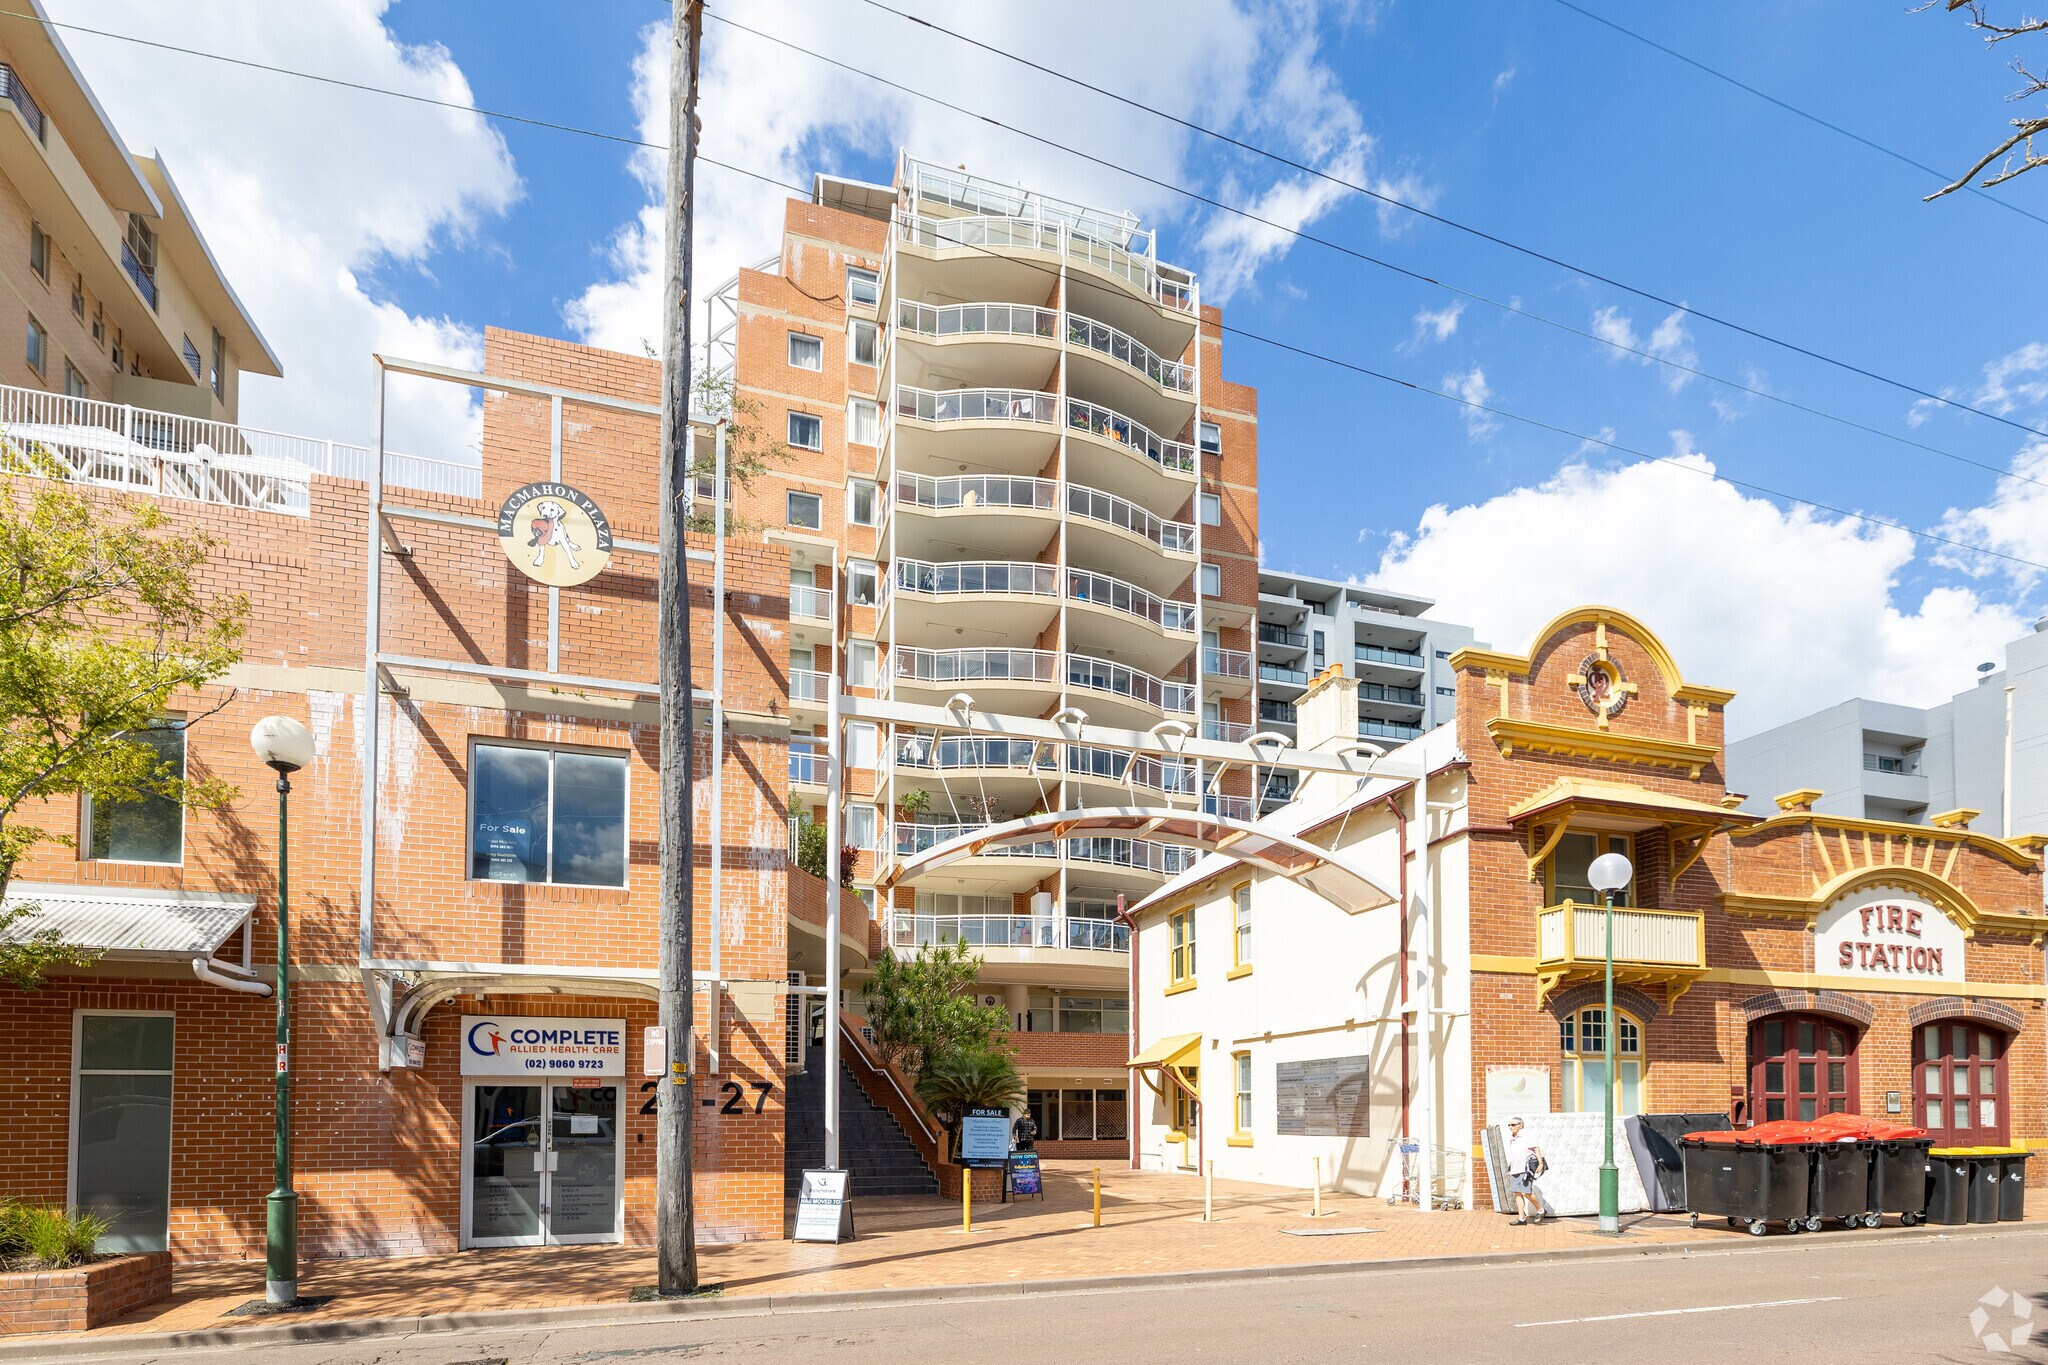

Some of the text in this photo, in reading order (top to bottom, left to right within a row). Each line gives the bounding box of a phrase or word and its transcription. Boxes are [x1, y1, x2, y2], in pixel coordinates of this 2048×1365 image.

[500, 484, 609, 548] MACMAHON PLAZA
[480, 823, 526, 835] For Sale
[1859, 905, 1922, 936] FIRE
[1839, 941, 1943, 972] STATION
[511, 1029, 620, 1045] COMPLETE
[651, 1029, 660, 1037] NO
[510, 1045, 546, 1053] ALLIED
[593, 1046, 619, 1054] CARE
[525, 1059, 603, 1069] (02) 9060 9723
